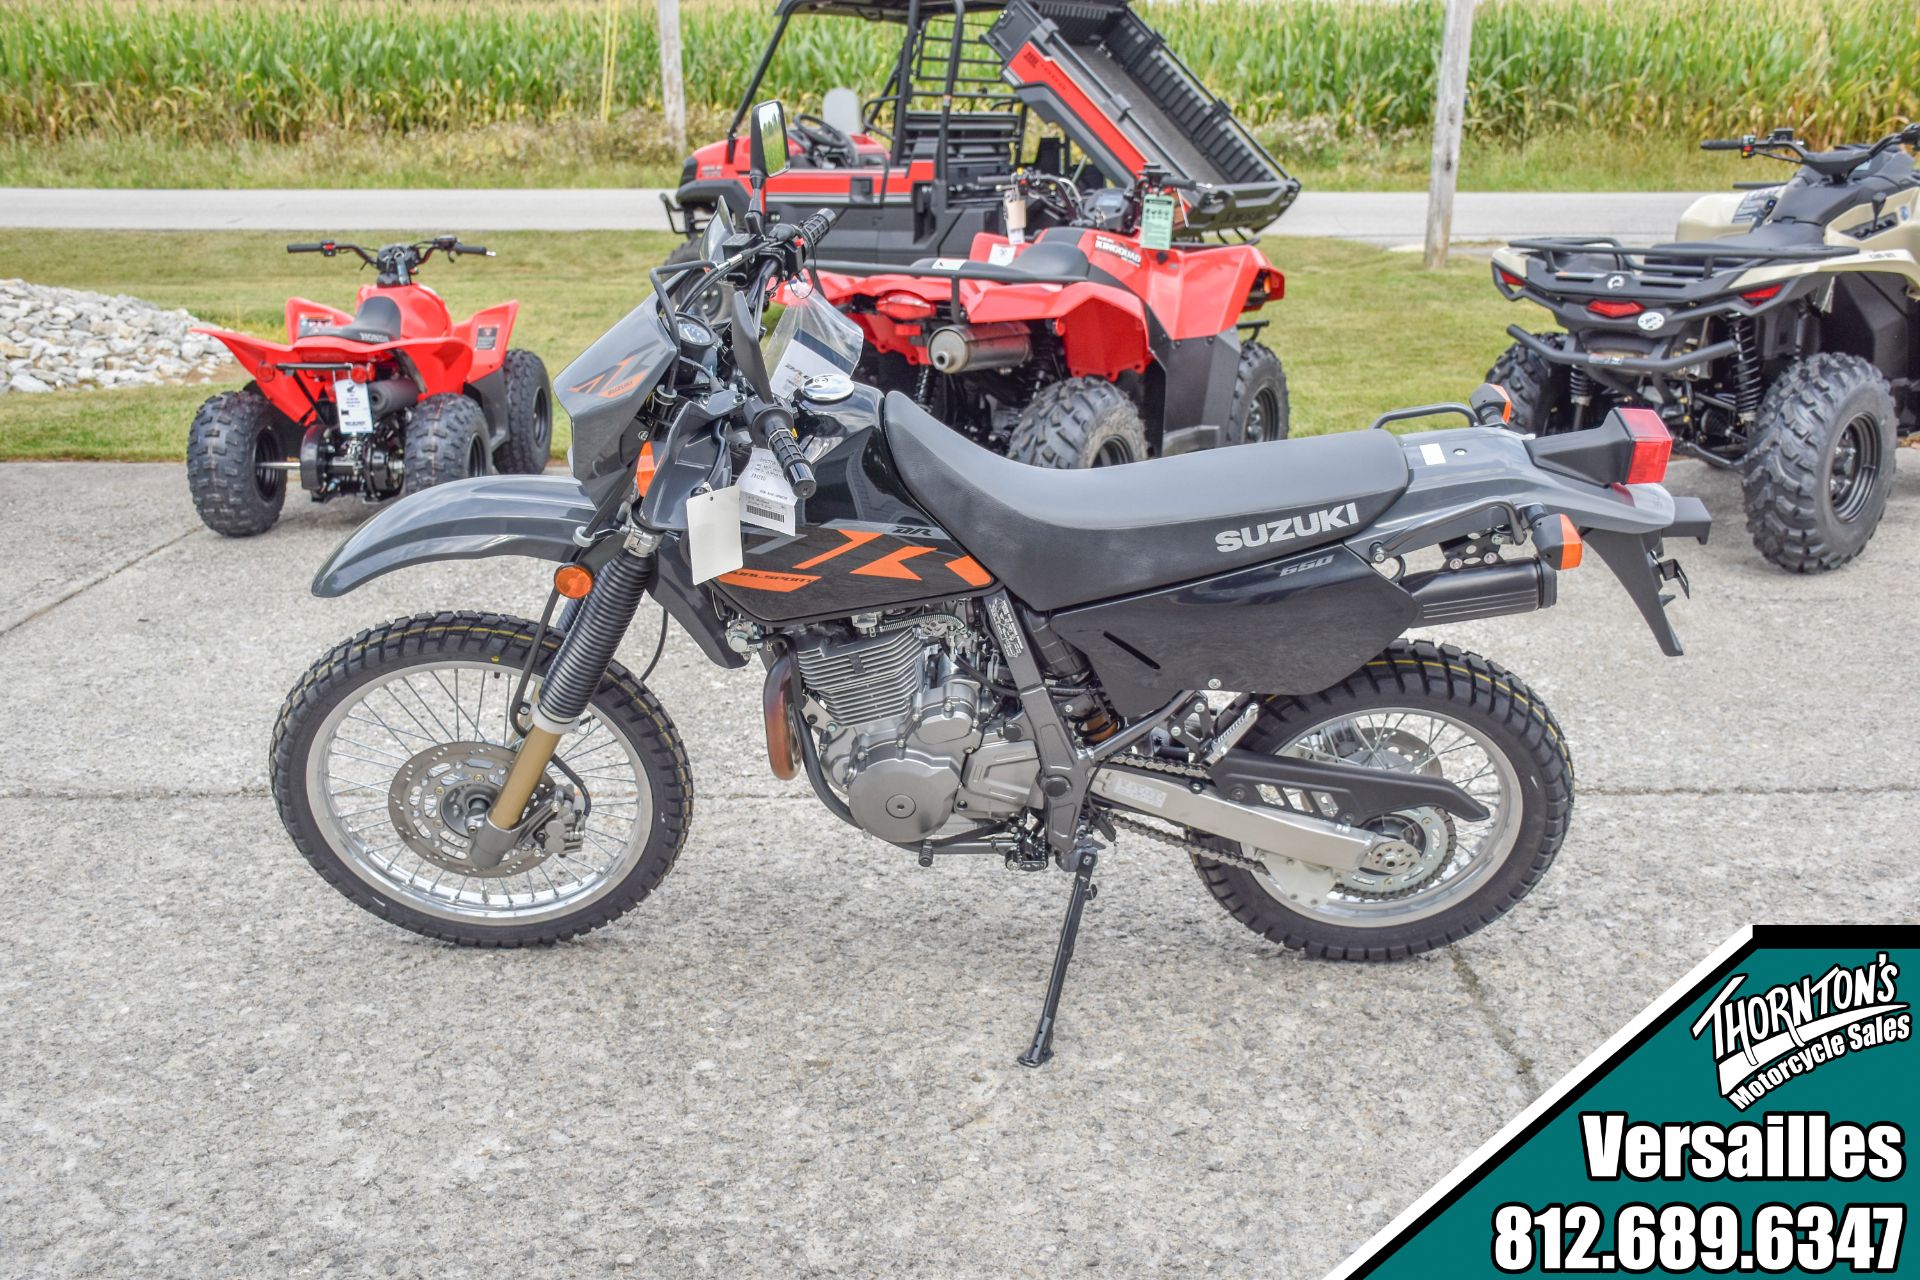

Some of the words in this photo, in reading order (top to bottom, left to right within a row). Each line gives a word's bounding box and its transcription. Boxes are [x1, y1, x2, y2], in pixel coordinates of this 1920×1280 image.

[360, 332, 389, 344] HONDA
[892, 525, 932, 537] DR
[1215, 502, 1360, 553] SUZUKI
[1279, 554, 1335, 577] 650
